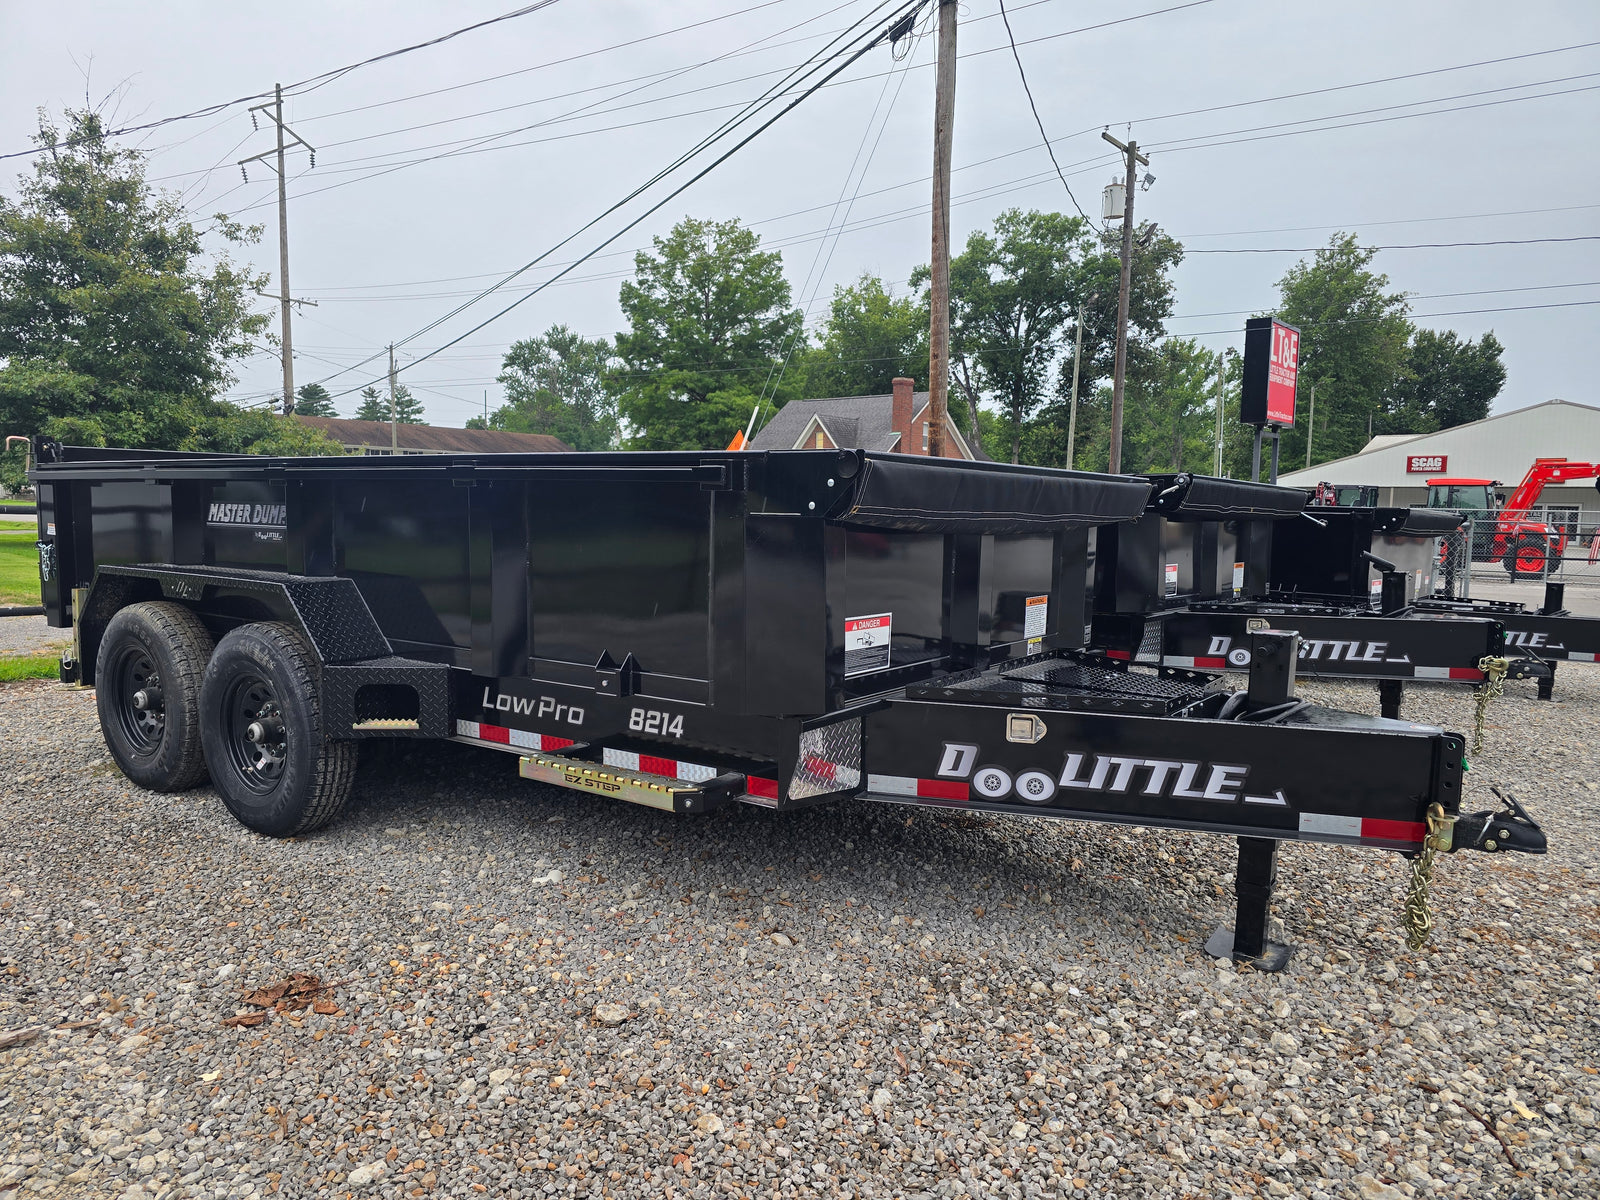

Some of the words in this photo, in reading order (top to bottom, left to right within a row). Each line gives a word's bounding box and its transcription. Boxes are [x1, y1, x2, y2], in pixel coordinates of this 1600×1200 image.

[1271, 325, 1297, 368] LT&E
[1411, 457, 1442, 467] SCAG
[208, 503, 251, 522] MASTER
[858, 619, 881, 630] DANGER
[629, 707, 684, 738] 8214
[563, 773, 582, 785] EZ
[584, 778, 621, 792] STEP
